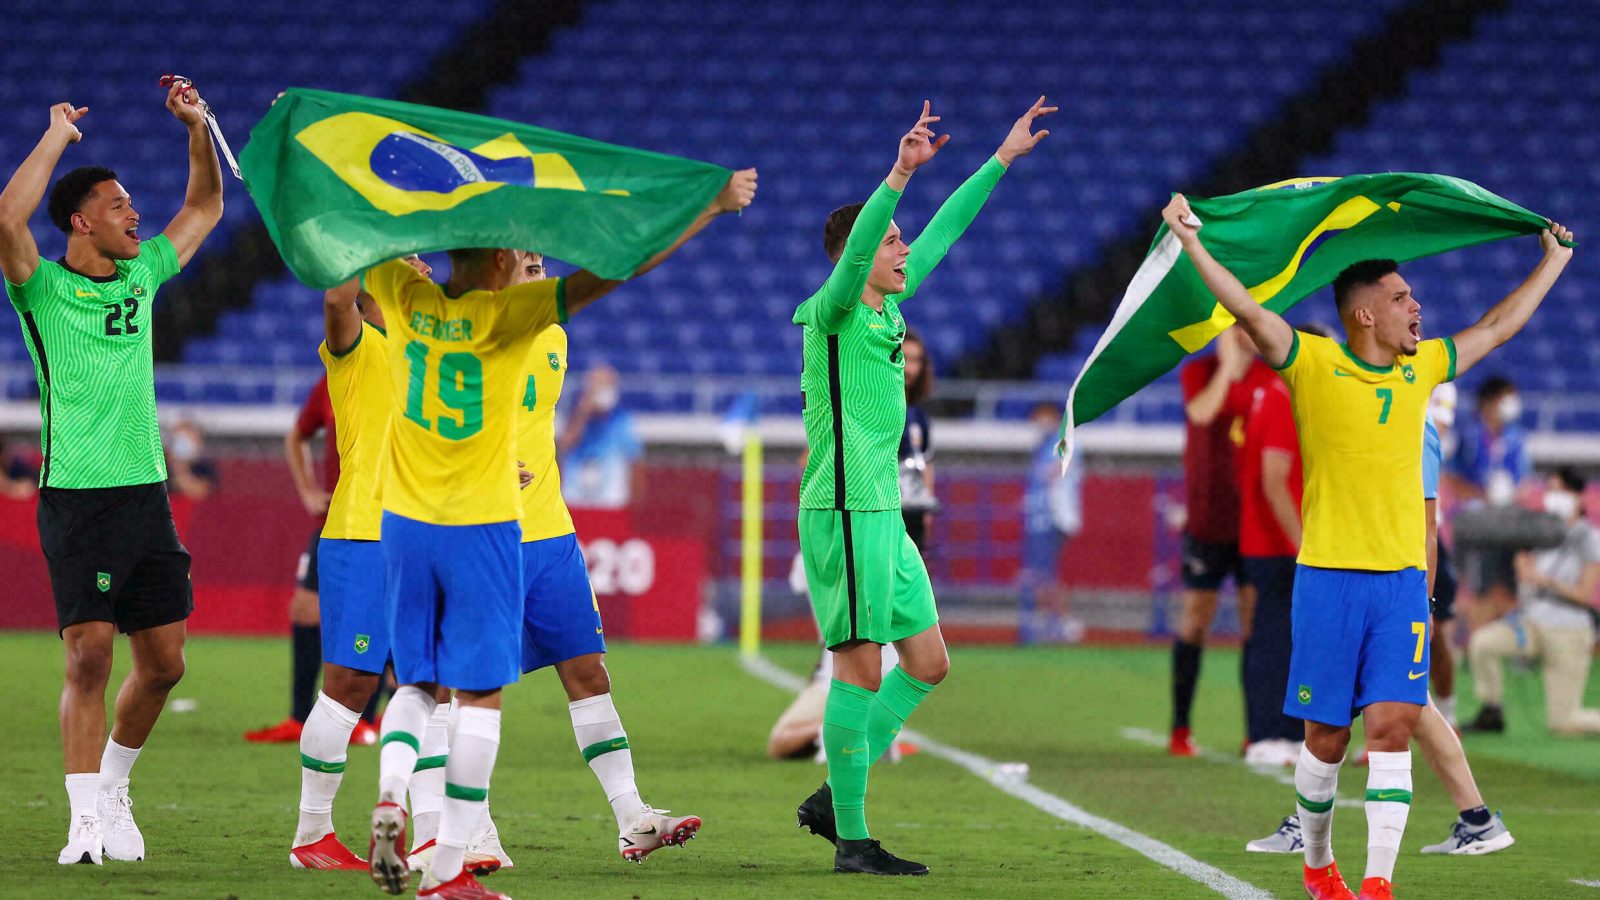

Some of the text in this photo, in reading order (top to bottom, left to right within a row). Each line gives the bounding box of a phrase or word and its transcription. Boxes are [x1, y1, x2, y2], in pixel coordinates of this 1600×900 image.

[103, 297, 139, 336] 22
[403, 339, 483, 441] 19
[522, 374, 537, 412] 4
[1376, 388, 1393, 425] 7
[1411, 621, 1426, 663] 7
